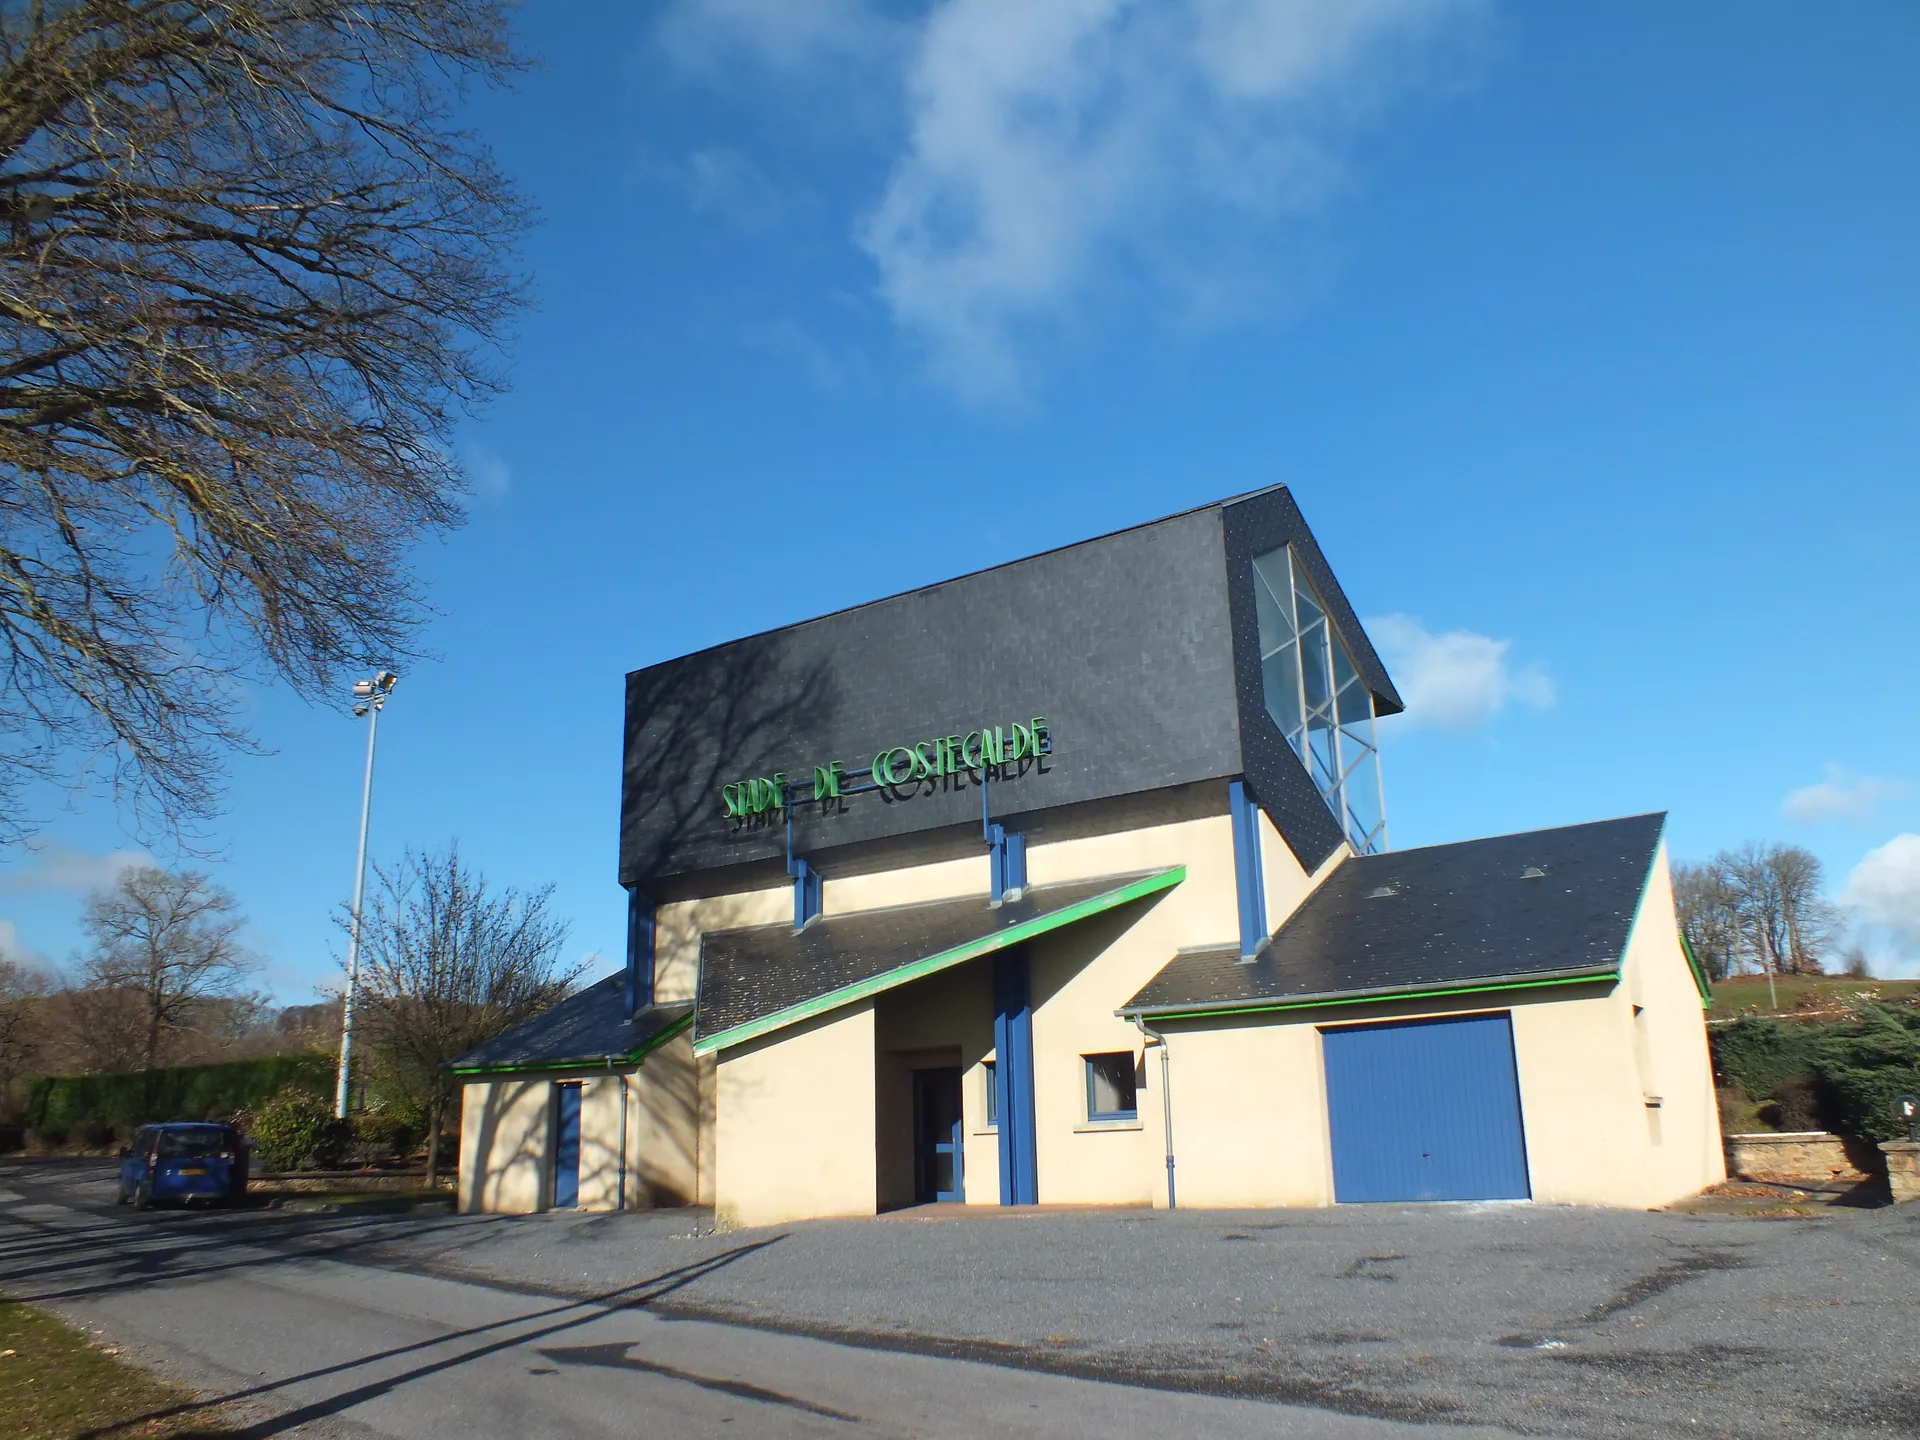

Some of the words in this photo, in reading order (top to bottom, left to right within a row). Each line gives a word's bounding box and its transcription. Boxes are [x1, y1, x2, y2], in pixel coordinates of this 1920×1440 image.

[723, 772, 790, 819] STADE
[814, 760, 848, 801] DE
[872, 717, 1051, 787] COSTECALDE
